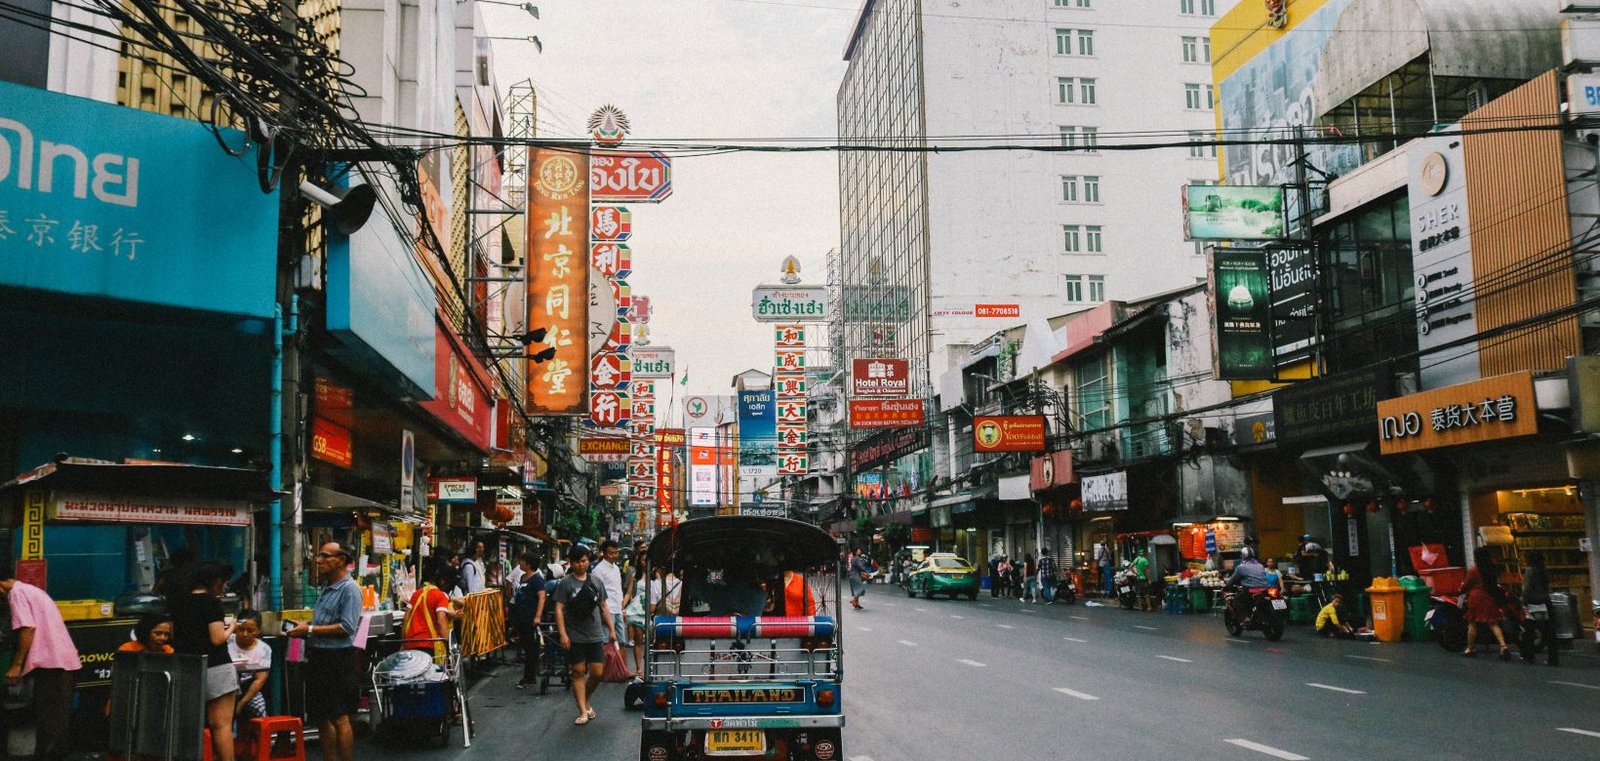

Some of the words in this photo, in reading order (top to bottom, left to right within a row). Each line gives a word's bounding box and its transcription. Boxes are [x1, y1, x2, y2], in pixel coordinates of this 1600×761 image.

[1585, 86, 1600, 106] B
[543, 205, 573, 395] 北京同仁堂
[856, 378, 878, 387] Hotel
[881, 378, 906, 388] Royal
[1430, 396, 1514, 432] 泰货大本营
[313, 435, 326, 453] GSB
[581, 441, 630, 451] EXCHANGE
[693, 689, 795, 702] THAILAND
[735, 731, 760, 743] 3411
